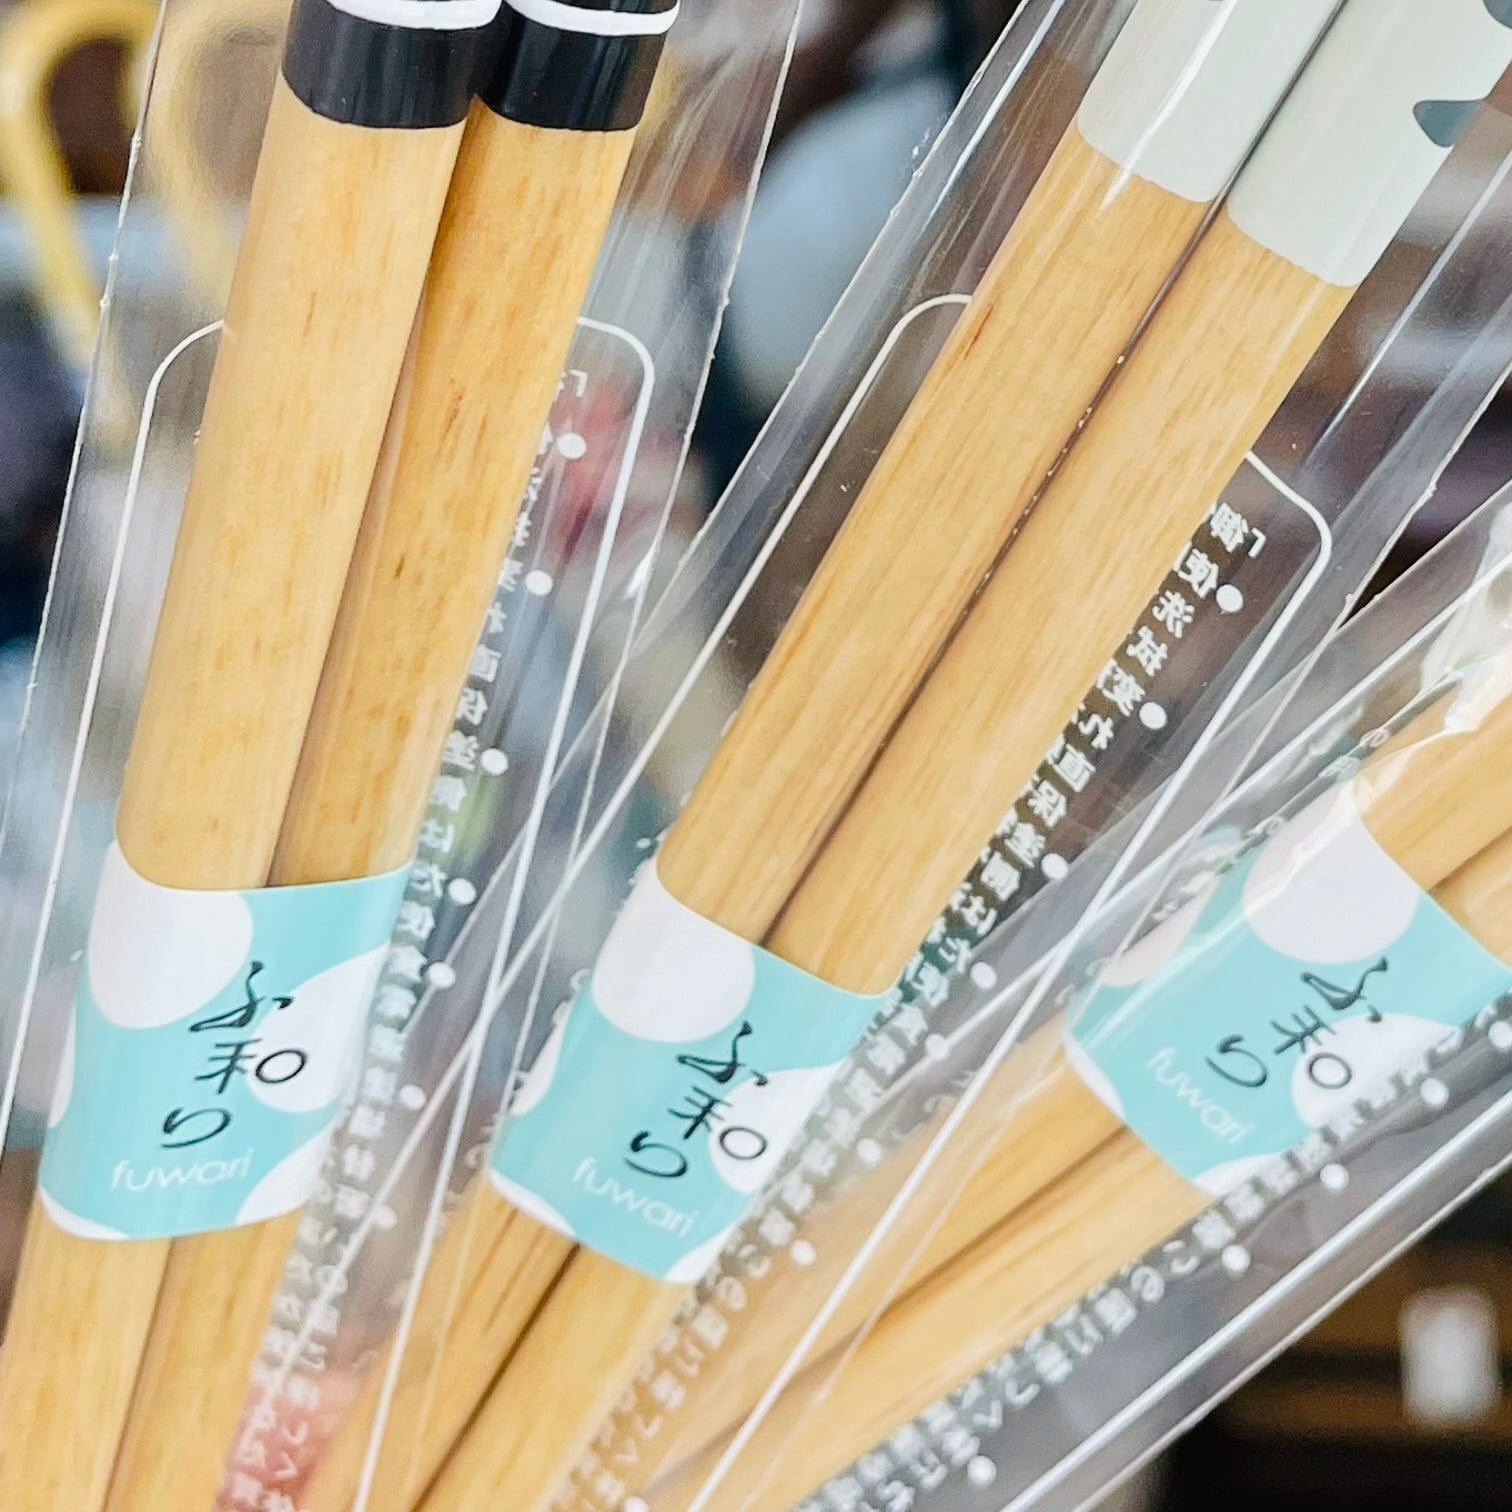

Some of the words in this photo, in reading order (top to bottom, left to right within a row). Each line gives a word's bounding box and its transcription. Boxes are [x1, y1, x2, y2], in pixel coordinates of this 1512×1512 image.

[160, 960, 307, 1149] ふ和り
[1205, 957, 1389, 1090] ふ和り
[624, 1020, 769, 1178] ふ和り
[1145, 1047, 1255, 1145] fuwari
[109, 1147, 255, 1192] fuwari
[572, 1156, 700, 1237] fuwari
